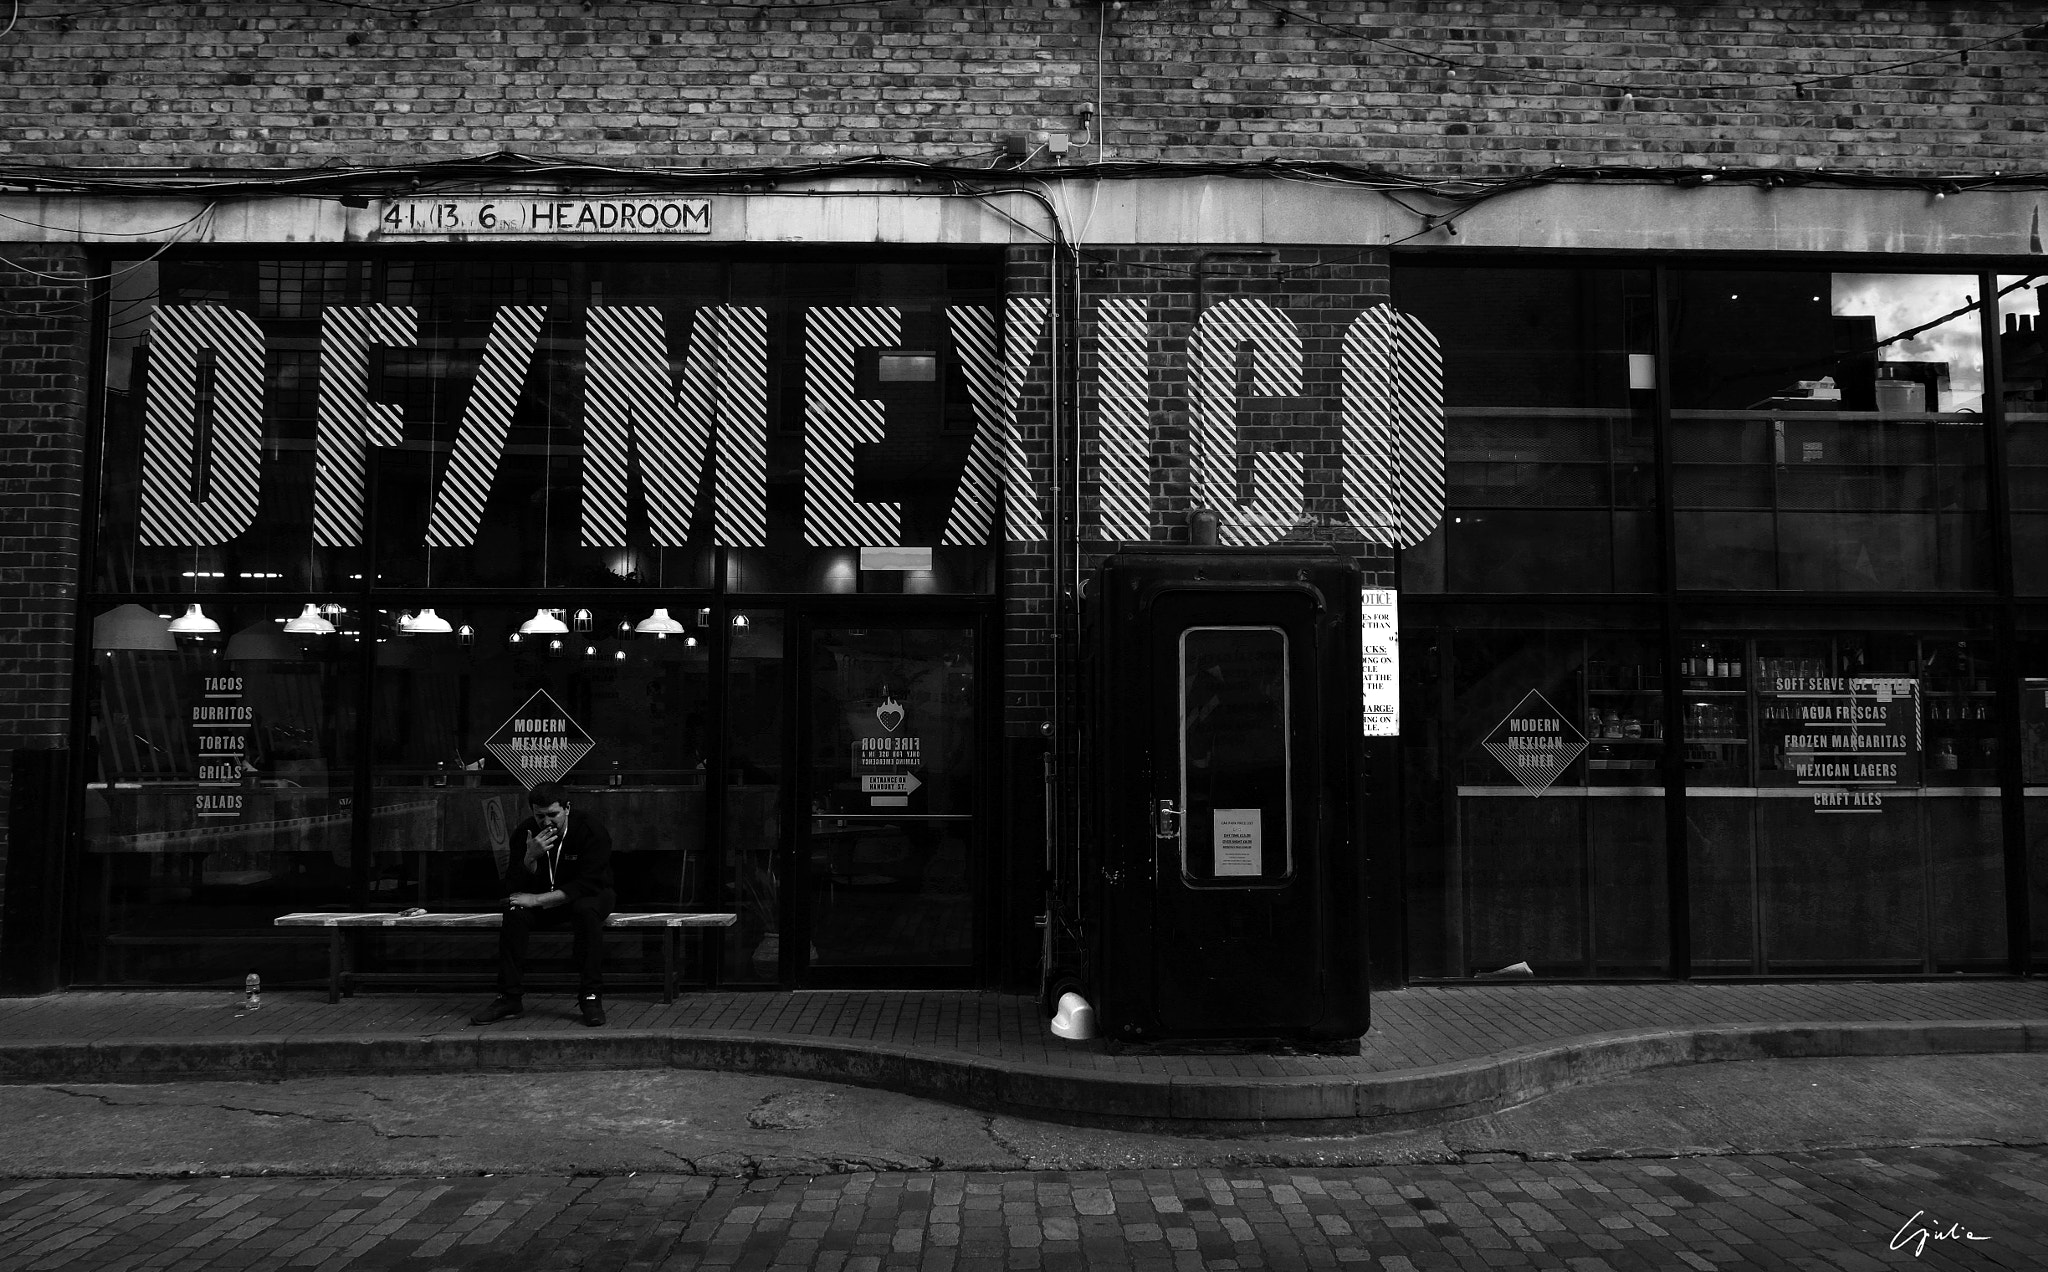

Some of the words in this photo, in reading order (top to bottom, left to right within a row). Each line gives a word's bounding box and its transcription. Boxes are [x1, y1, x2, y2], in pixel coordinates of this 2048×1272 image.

[430, 203, 473, 229] (13
[531, 203, 710, 230] HEADROOM
[1361, 592, 1393, 605] OTICE
[1373, 613, 1389, 621] FOR
[1367, 621, 1391, 629] THAN
[1364, 645, 1387, 653] CKS:
[1362, 665, 1378, 673] CLE
[204, 677, 243, 691] TACOS
[1374, 673, 1392, 681] THE
[1776, 677, 1805, 691] SOFT
[1809, 677, 1845, 691] SERVE
[1367, 682, 1384, 690] THE
[192, 706, 253, 720] BURRITOS
[1363, 704, 1394, 713] ARGE:
[1802, 706, 1832, 720] AGUA
[1836, 706, 1887, 720] FRESCAS
[514, 718, 566, 733] MODERN
[1510, 718, 1560, 732] MODERN
[199, 735, 245, 750] TORTAS
[511, 736, 568, 751] MEXICAN
[1508, 736, 1563, 750] MEXICAN
[1784, 734, 1828, 748] FROZEN
[1831, 734, 1907, 748] MARGARITAS
[521, 754, 558, 769] DINER
[1517, 754, 1554, 768] DINER
[199, 765, 242, 779] GRILLS
[1796, 763, 1850, 777] MEXICAN
[1853, 763, 1898, 777] LAGERS
[195, 795, 243, 809] SALADS
[1813, 792, 1850, 806] CRAFT
[1853, 792, 1882, 806] ALES
